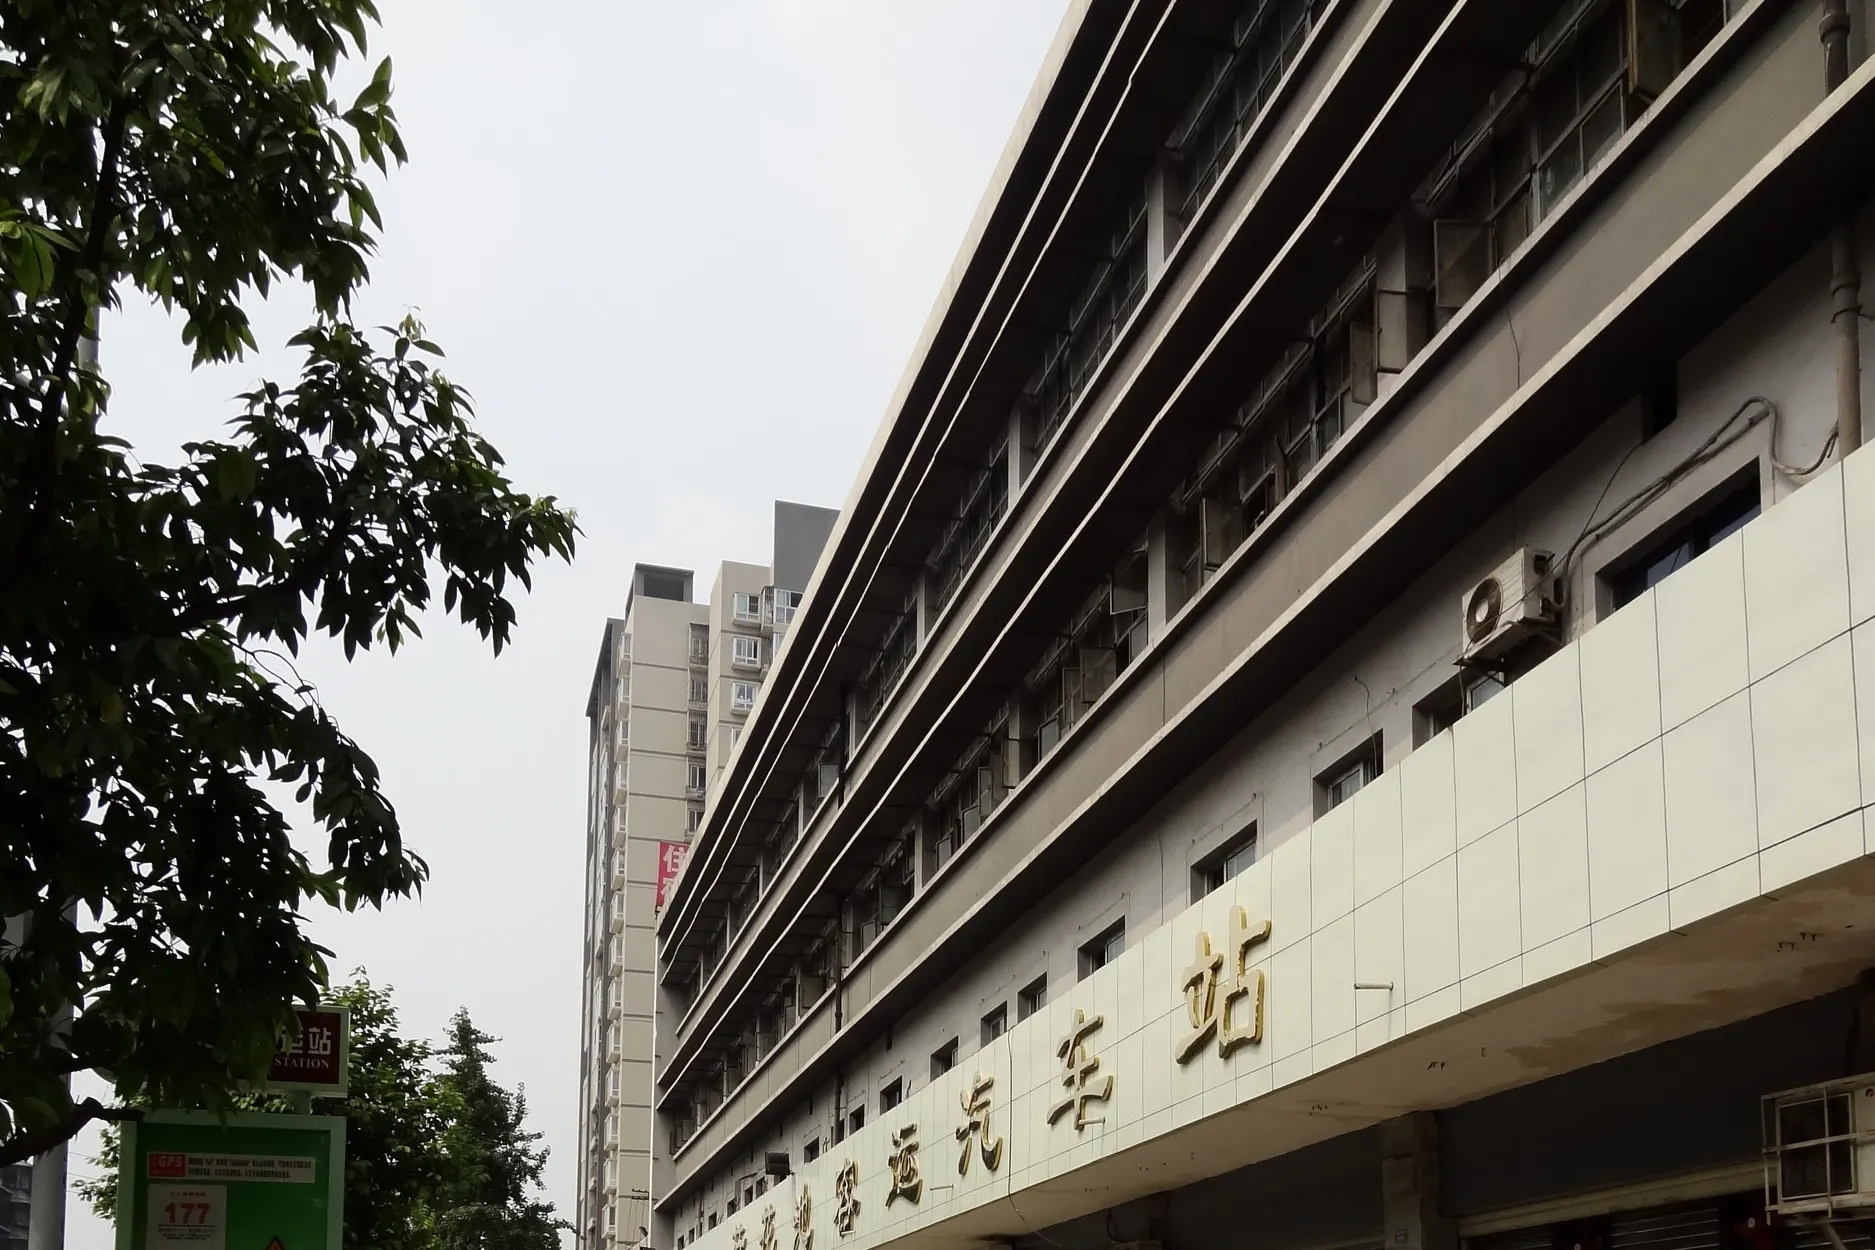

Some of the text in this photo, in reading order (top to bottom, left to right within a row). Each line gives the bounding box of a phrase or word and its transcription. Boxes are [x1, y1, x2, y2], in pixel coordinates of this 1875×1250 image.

[275, 1057, 329, 1068] STATION
[158, 1156, 183, 1168] GPS
[165, 1202, 210, 1224] 177
